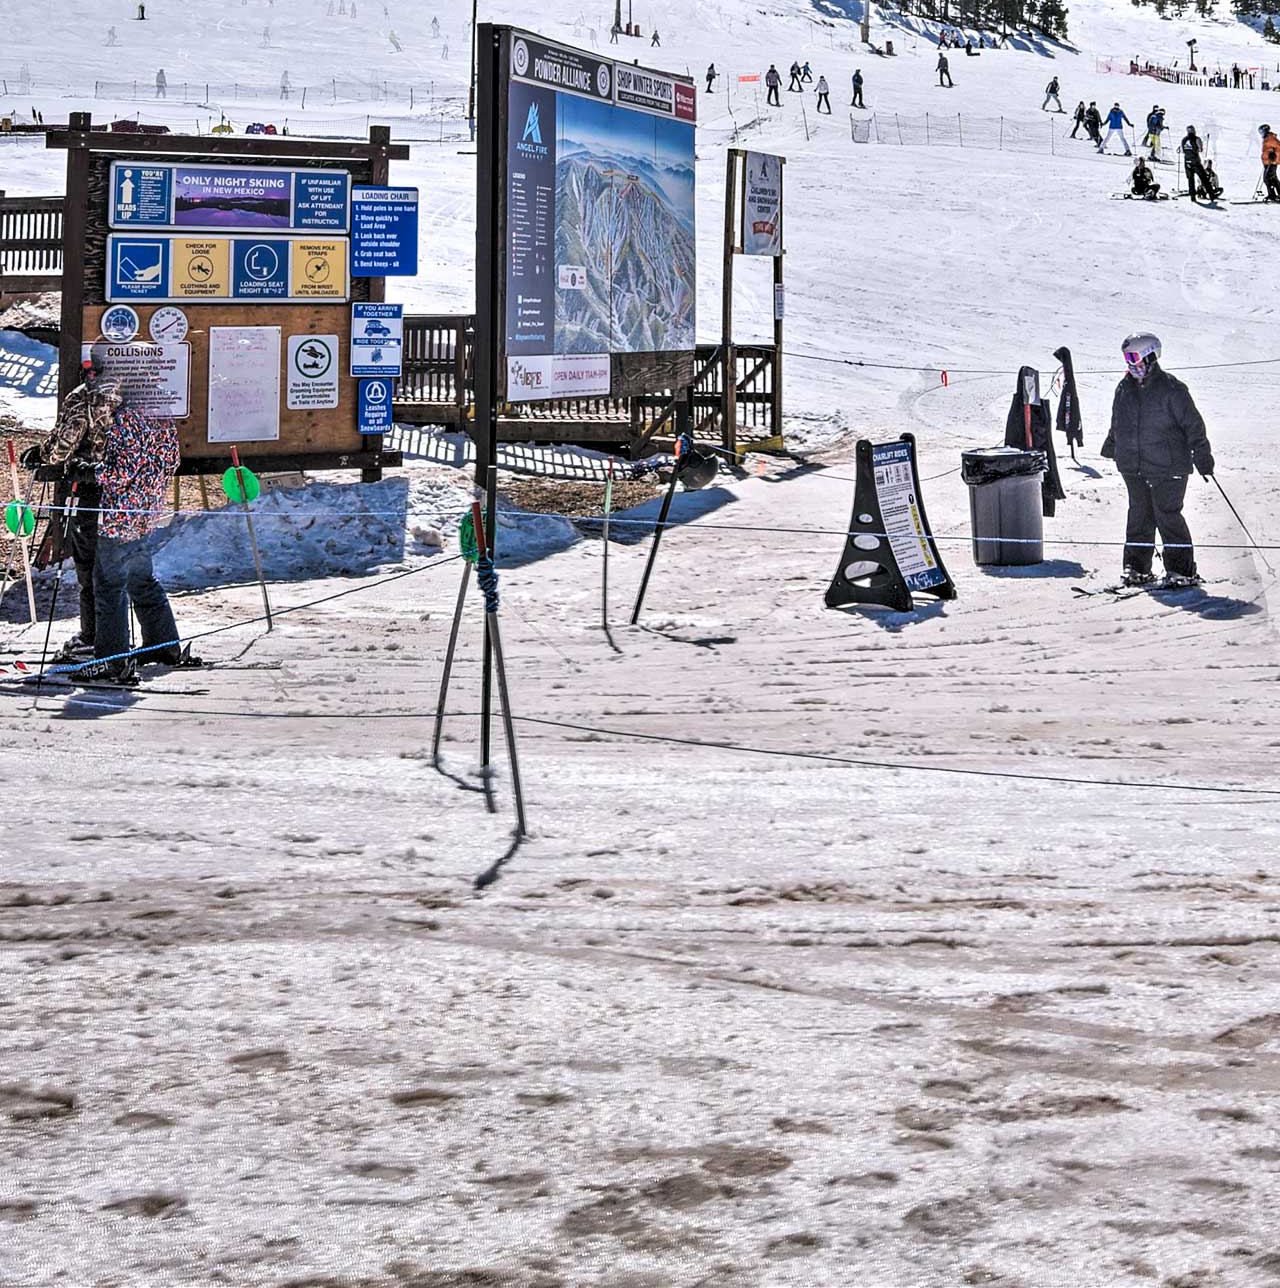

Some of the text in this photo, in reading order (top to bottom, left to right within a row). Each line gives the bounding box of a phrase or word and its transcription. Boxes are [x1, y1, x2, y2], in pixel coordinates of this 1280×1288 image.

[534, 58, 561, 83] POWDER
[562, 66, 591, 91] ALLIANCE
[617, 69, 631, 89] SHOP
[633, 73, 653, 94] WINTER
[654, 79, 672, 100] SPORTS
[516, 142, 548, 154] ANGEL FIRE
[183, 176, 285, 188] ONLY NIGHT SKIING
[361, 192, 389, 200] LOADING
[107, 347, 164, 357] COLLISIONS
[553, 371, 567, 381] OPEN
[569, 370, 584, 381] DAILY
[872, 448, 908, 462] CHAIRLIFT RIDES
